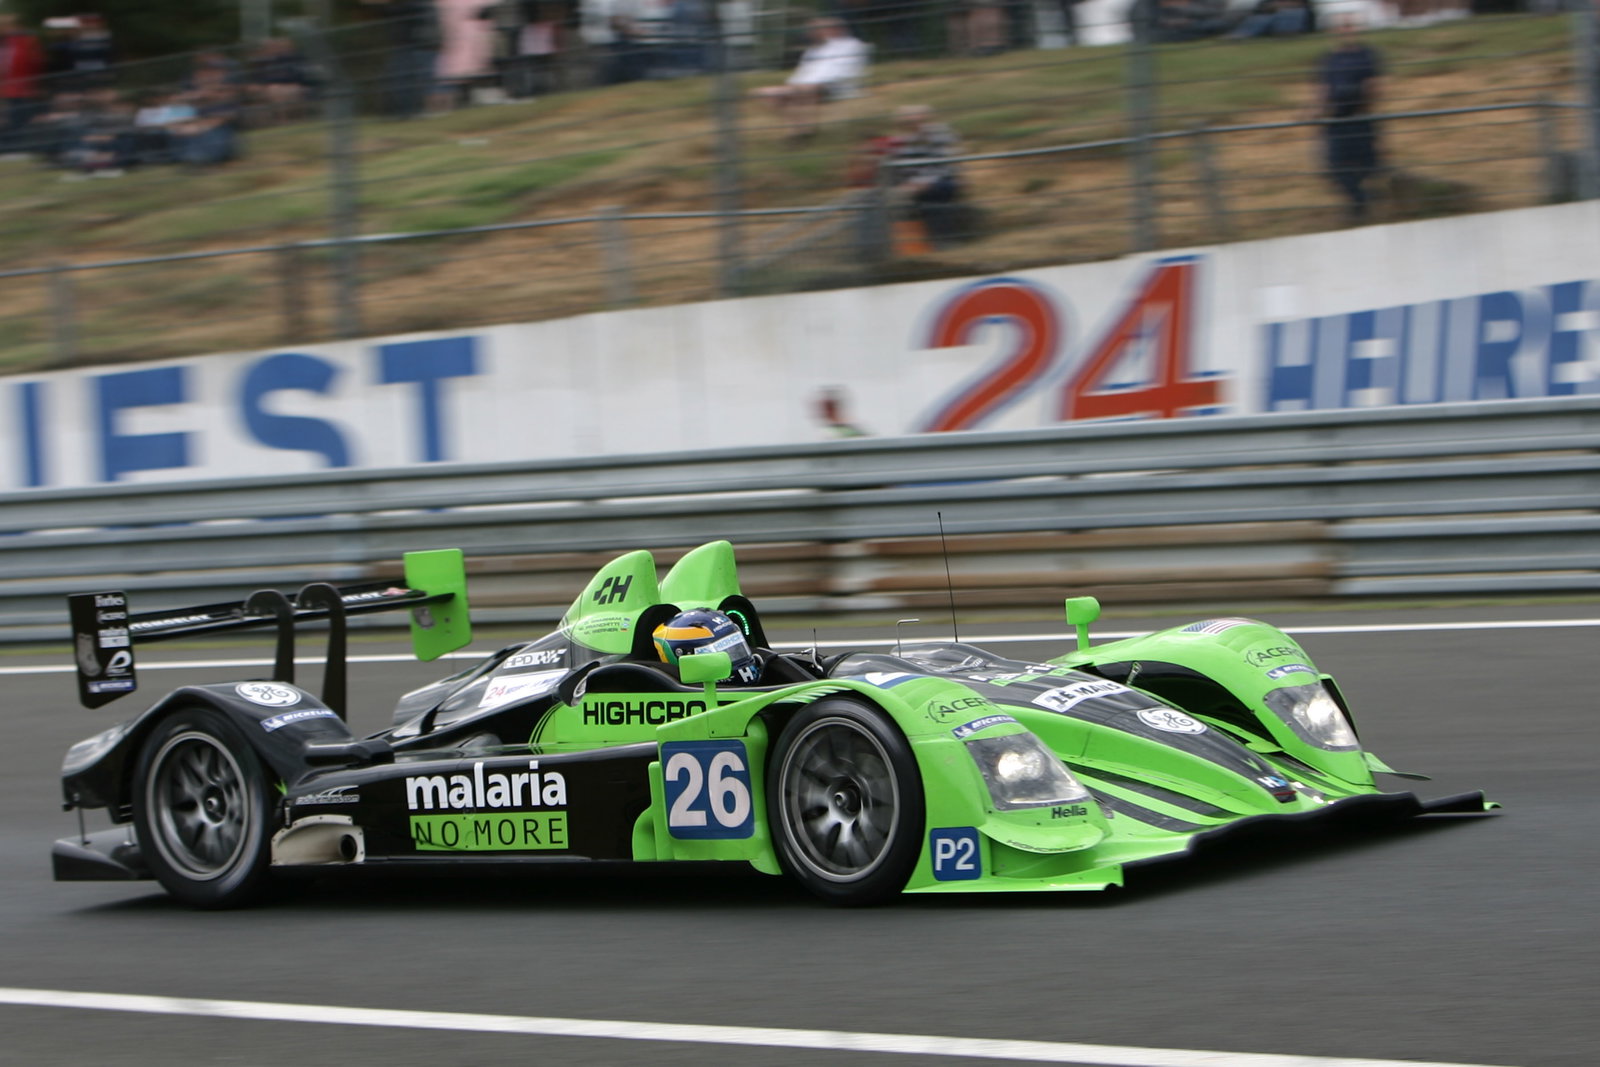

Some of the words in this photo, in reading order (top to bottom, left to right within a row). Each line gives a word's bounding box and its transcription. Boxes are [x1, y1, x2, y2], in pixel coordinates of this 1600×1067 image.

[920, 253, 1228, 432] 24
[583, 701, 747, 726] HIGHCRO
[405, 760, 567, 810] malaria
[665, 751, 751, 828] 26
[1051, 805, 1088, 819] Hella
[414, 820, 460, 846] NO
[474, 818, 564, 846] MORE
[935, 837, 975, 871] P2
